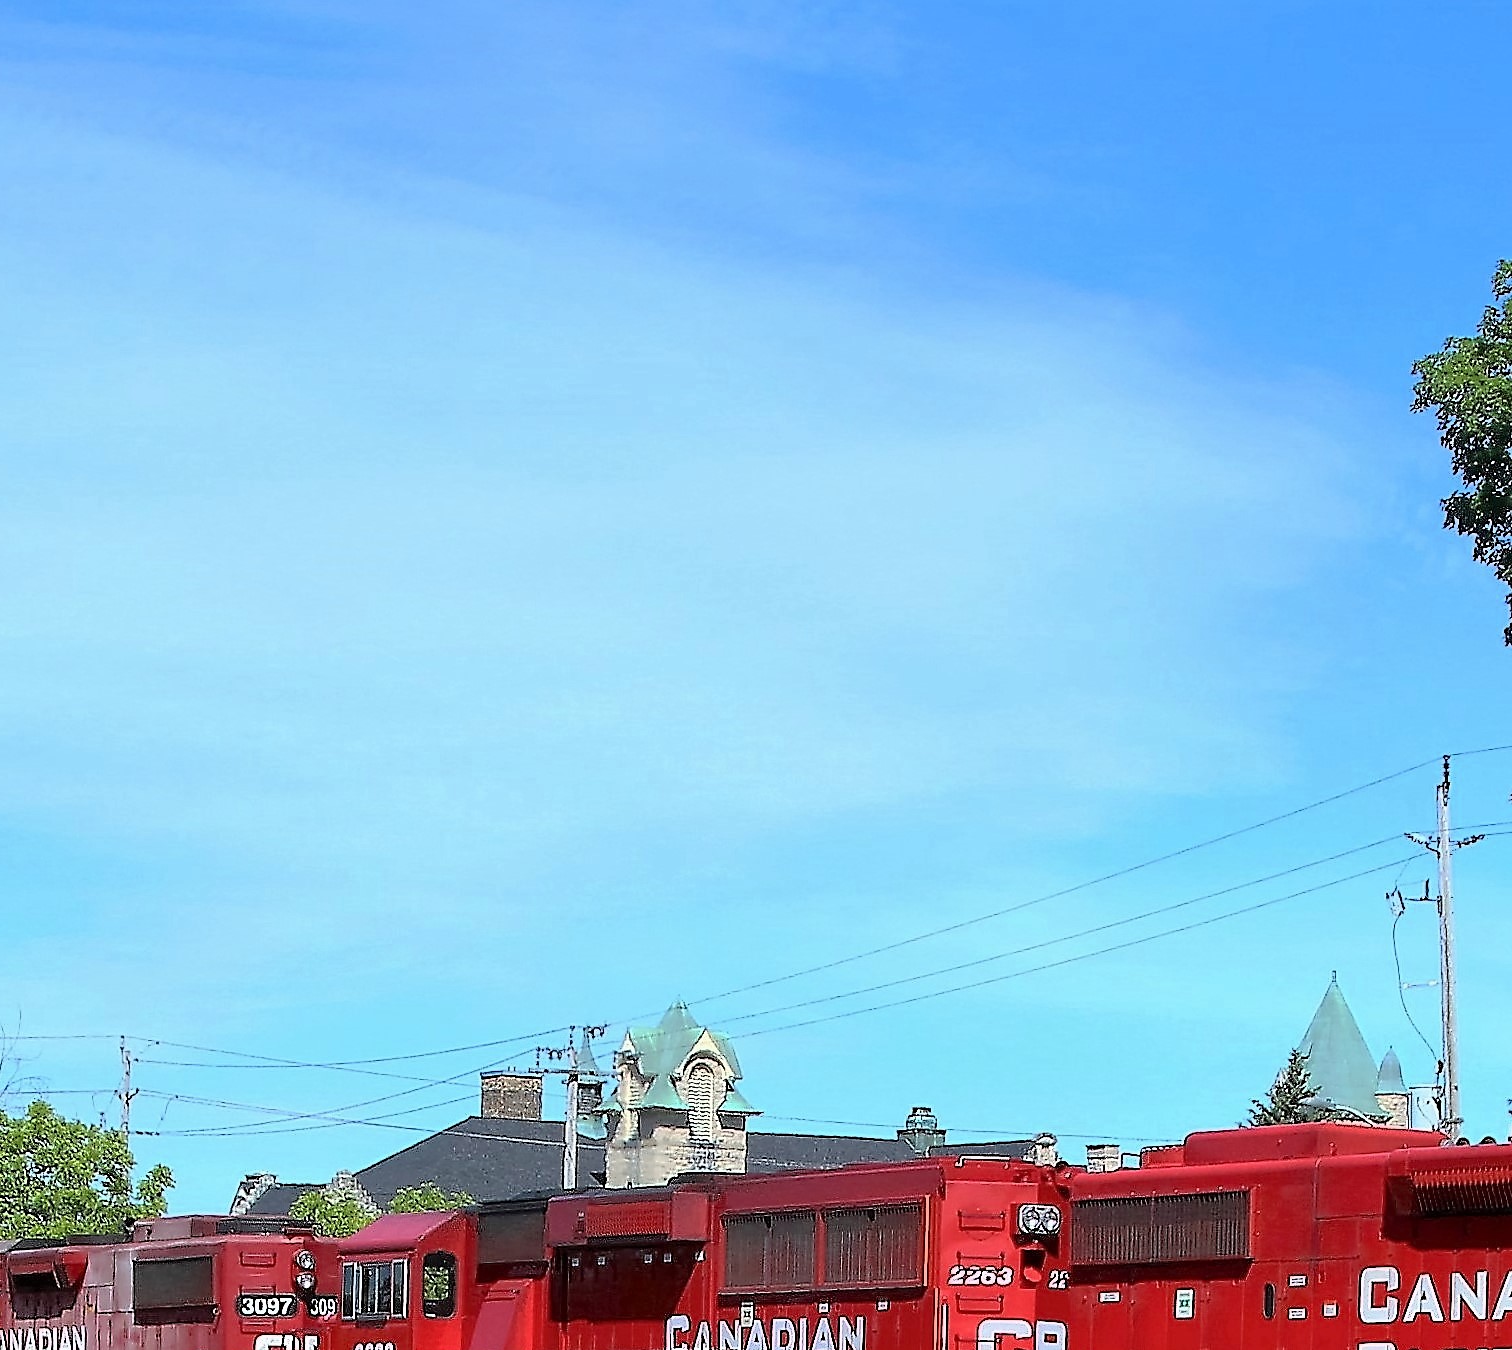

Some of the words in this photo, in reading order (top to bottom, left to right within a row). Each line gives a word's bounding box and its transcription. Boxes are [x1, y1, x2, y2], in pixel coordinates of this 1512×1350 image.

[948, 1265, 1014, 1286] 2263
[241, 1297, 293, 1316] 3097
[310, 1298, 338, 1316] 309
